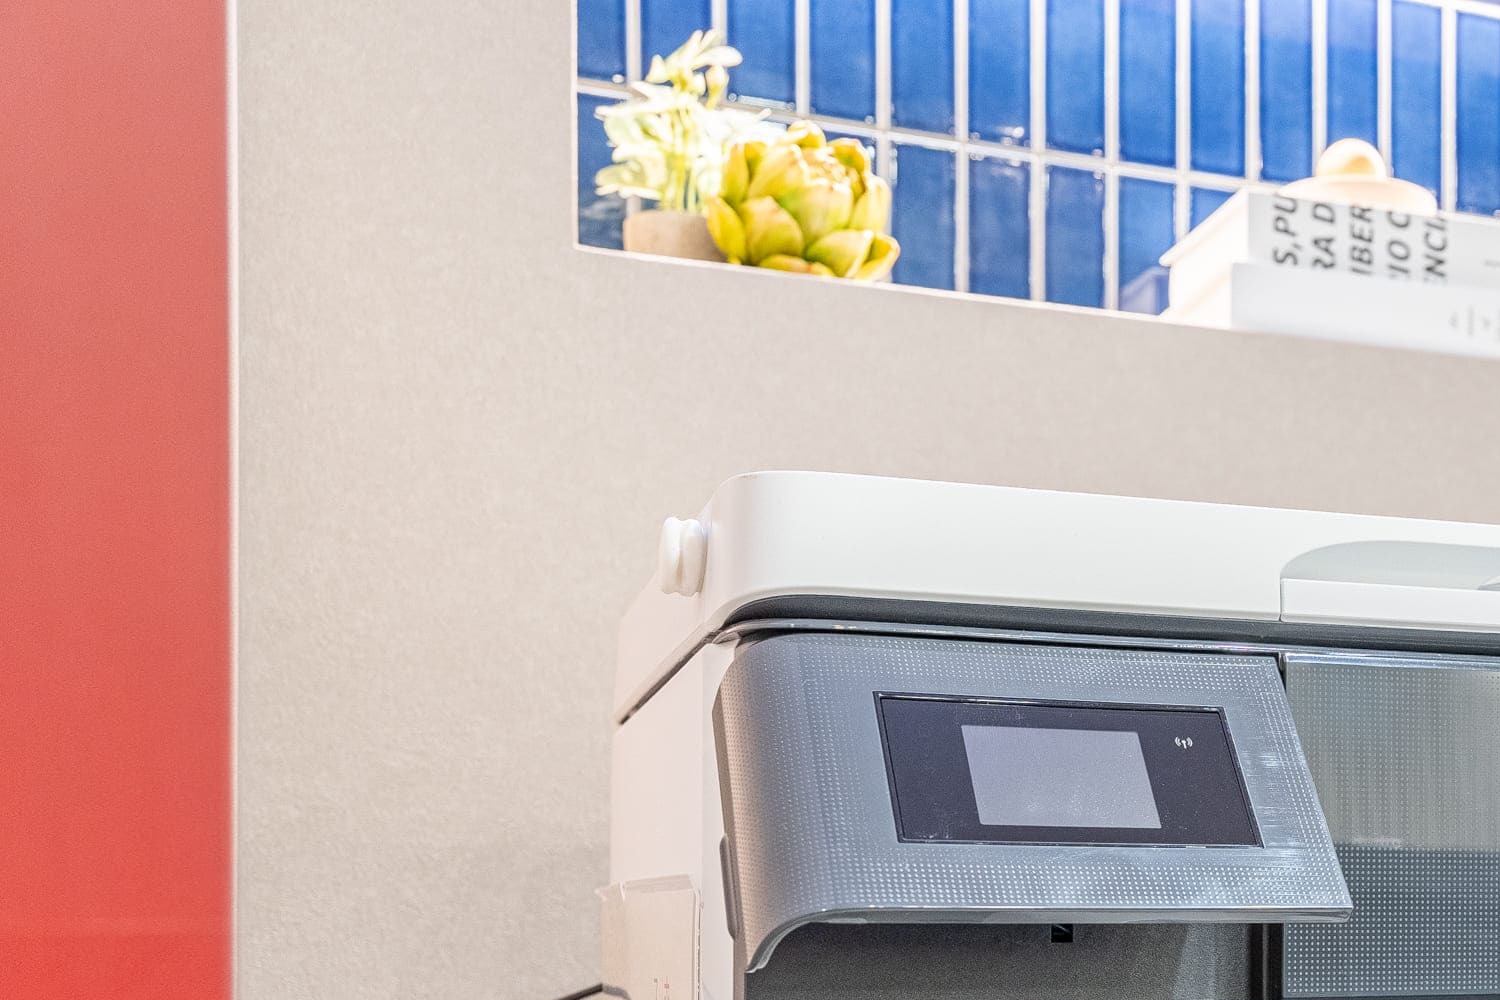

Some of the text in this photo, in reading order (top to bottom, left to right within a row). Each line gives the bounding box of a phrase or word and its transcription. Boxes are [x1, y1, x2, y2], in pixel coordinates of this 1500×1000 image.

[1311, 203, 1335, 224] D
[1386, 240, 1411, 280] IO
[1423, 217, 1448, 282] NCI
